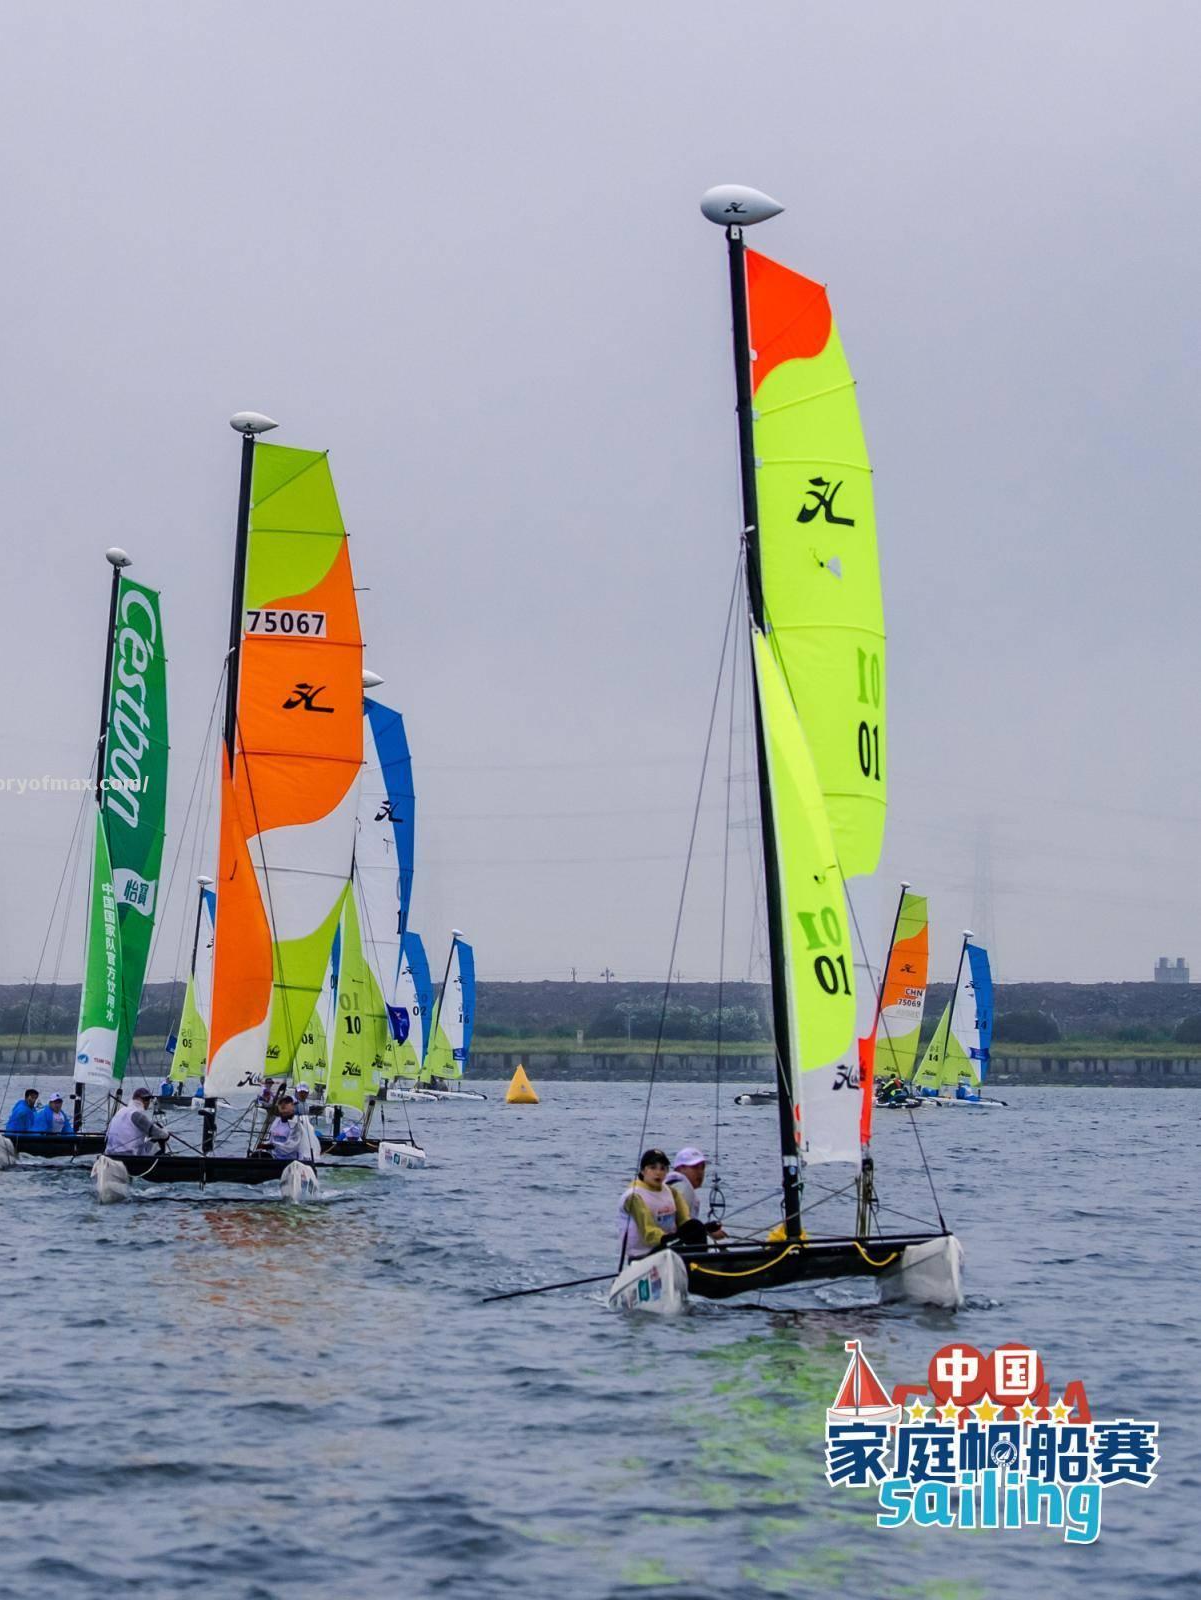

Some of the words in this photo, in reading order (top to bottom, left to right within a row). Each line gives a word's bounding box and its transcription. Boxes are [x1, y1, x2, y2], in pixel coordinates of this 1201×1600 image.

[247, 611, 325, 635] 75067
[858, 721, 880, 781] 01
[814, 954, 852, 996] 01
[905, 988, 923, 997] CHN
[898, 998, 921, 1007] 75069
[413, 1006, 427, 1016] 02
[344, 1016, 361, 1034] 10
[301, 1034, 314, 1045] 08
